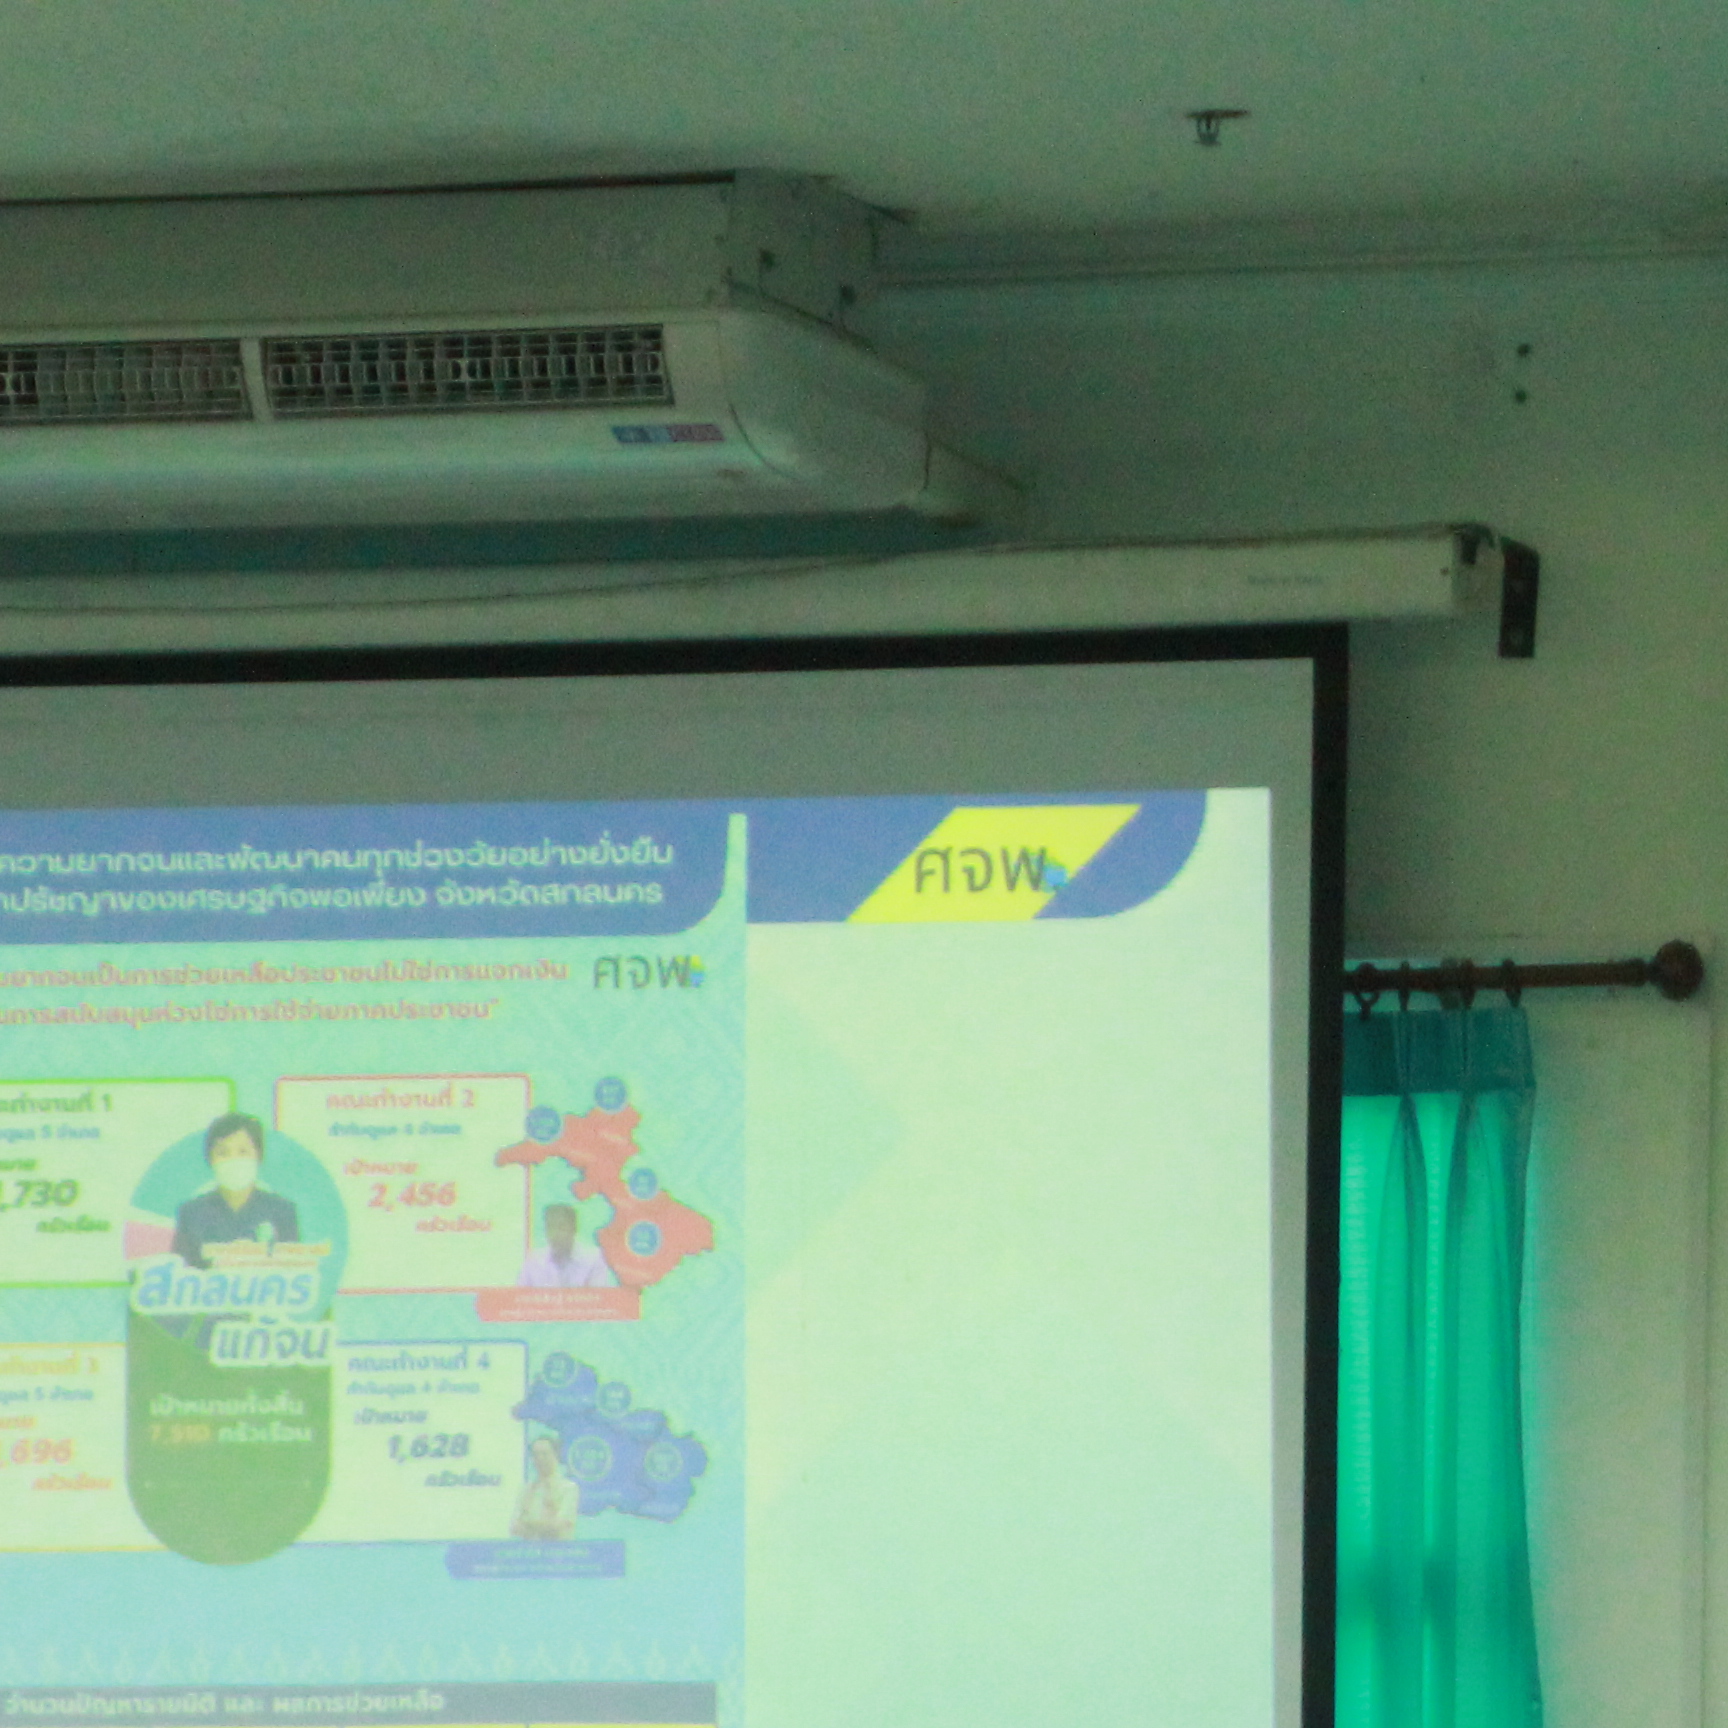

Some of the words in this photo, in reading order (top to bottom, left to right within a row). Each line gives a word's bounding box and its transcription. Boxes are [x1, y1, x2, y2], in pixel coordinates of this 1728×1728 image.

[913, 845, 1049, 894] ศจพ
[435, 878, 664, 909] จังหวัดสกลนคร
[593, 953, 693, 990] ศจพ
[102, 1093, 112, 1113] 1
[461, 1088, 476, 1108] 2
[368, 1181, 457, 1212] 2,456
[137, 1261, 314, 1309] สกลนคร
[216, 1316, 331, 1362] แก้จน
[86, 1356, 99, 1374] 3
[476, 1351, 491, 1371] 4
[387, 1433, 470, 1465] 1,628
